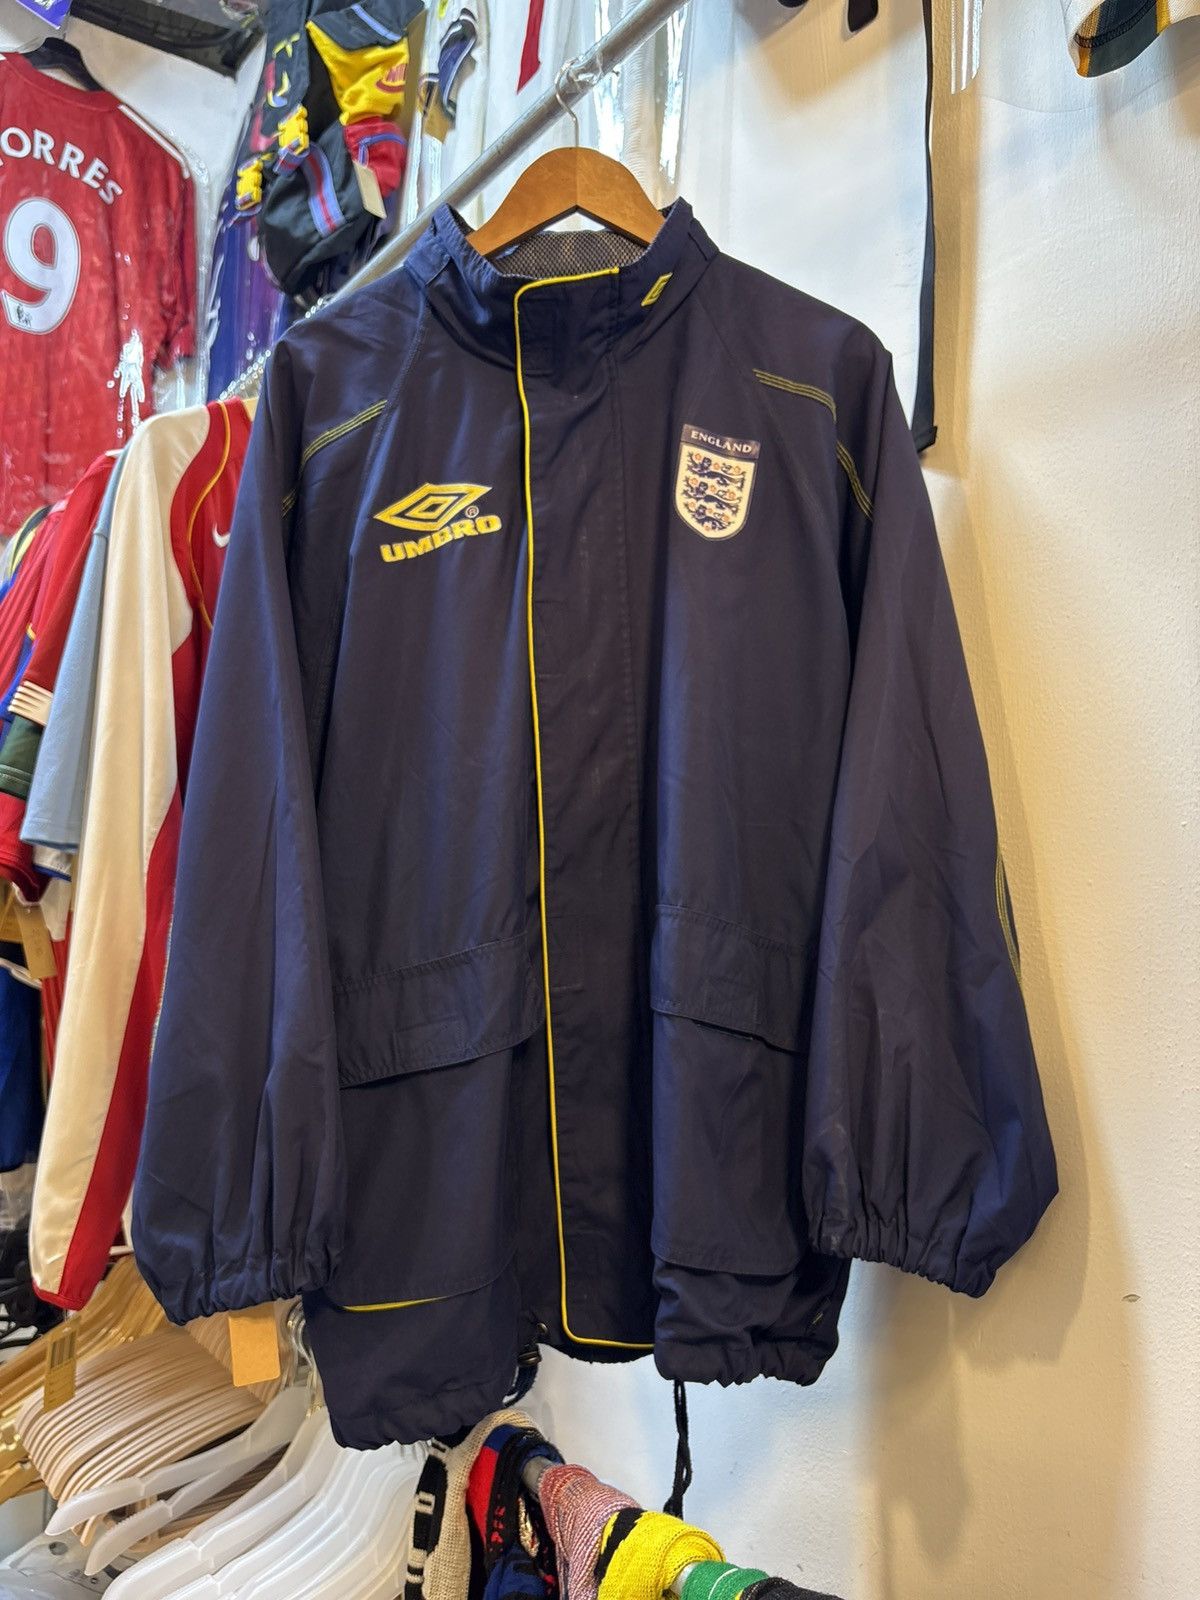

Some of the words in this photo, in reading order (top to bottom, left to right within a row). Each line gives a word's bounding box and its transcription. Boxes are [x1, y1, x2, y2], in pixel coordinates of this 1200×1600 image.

[0, 126, 124, 206] ORRES
[2, 197, 81, 335] 9
[690, 430, 753, 454] ENGLAND
[380, 514, 502, 563] UMBRO
